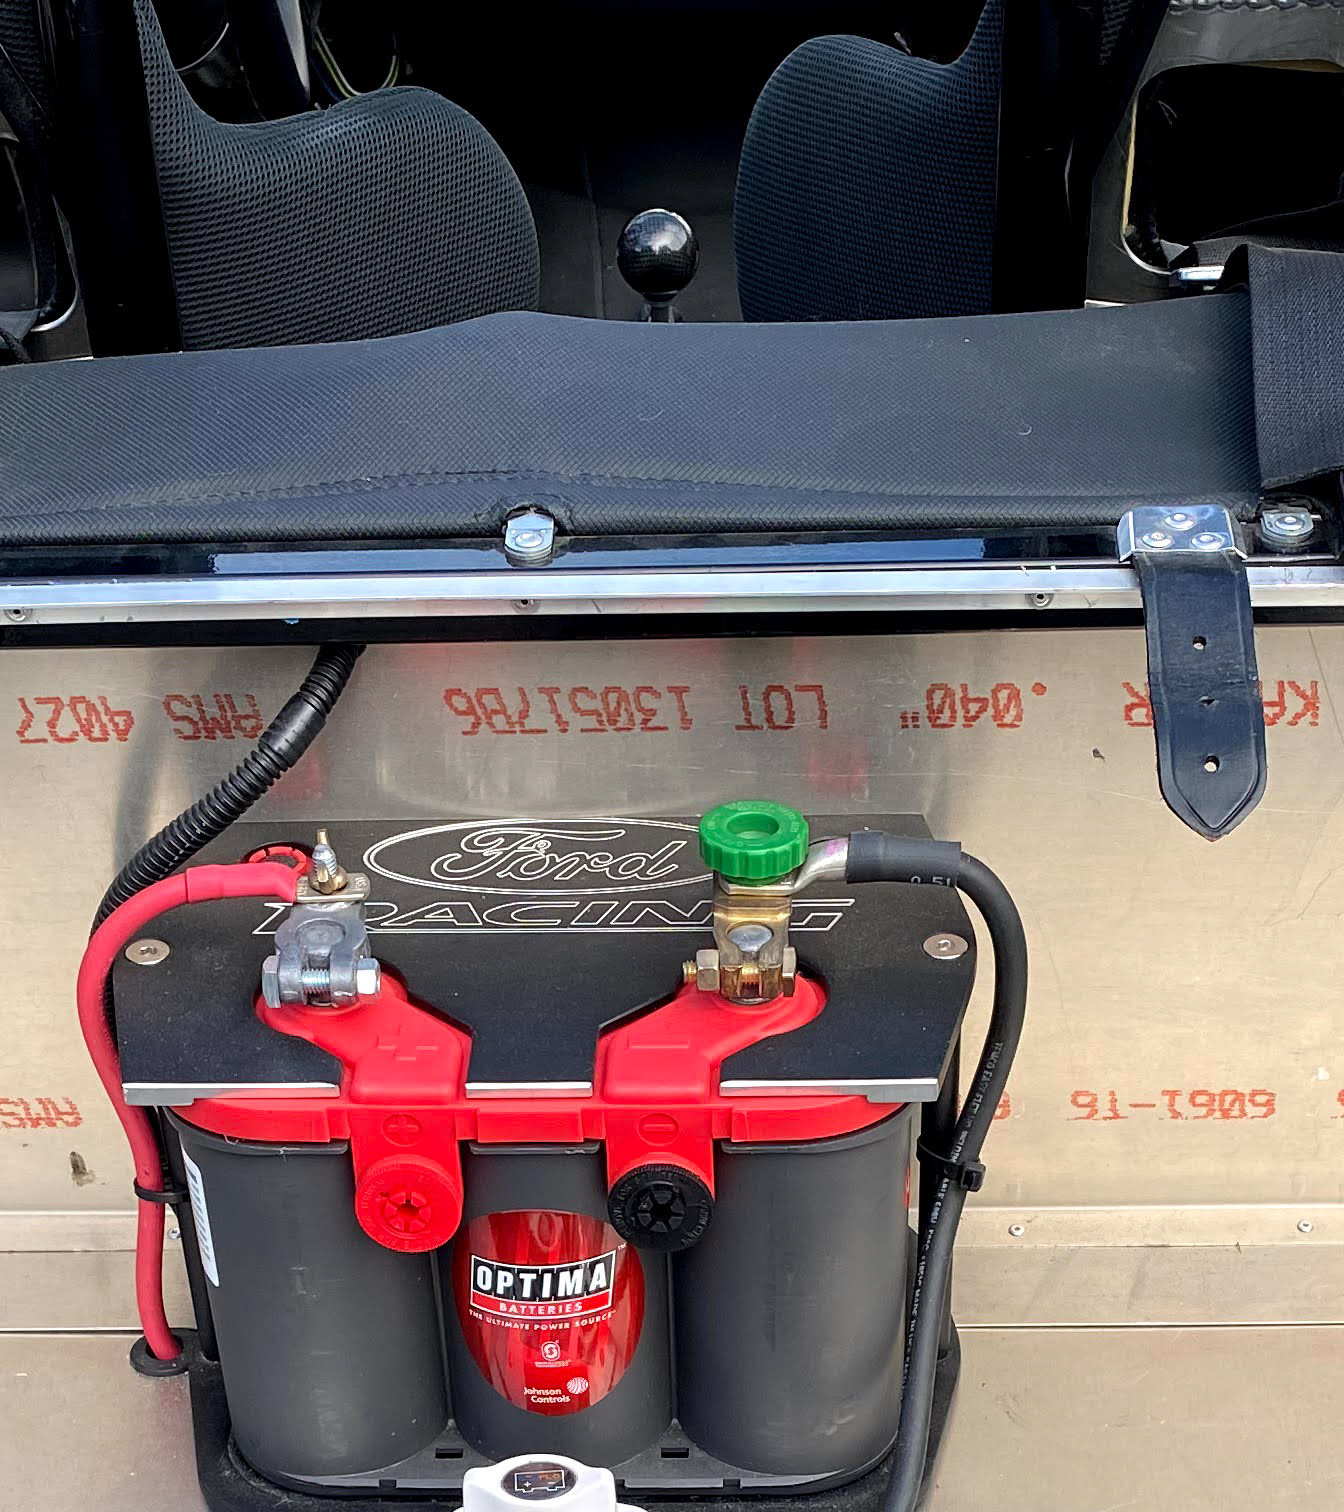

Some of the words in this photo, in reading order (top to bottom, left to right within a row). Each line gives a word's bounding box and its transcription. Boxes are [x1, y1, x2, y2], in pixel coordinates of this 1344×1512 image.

[15, 696, 136, 745] 4027
[163, 695, 265, 742] AMS
[734, 683, 829, 732] LOT
[428, 828, 686, 882] Ford
[1069, 1088, 1277, 1122] 6061-T6
[476, 1262, 608, 1299] OPTIMA
[469, 1308, 483, 1321] THE
[485, 1316, 530, 1331] ULTIMATE
[534, 1323, 570, 1331] POWER
[575, 1312, 613, 1328] SOURCE
[499, 1301, 583, 1315] BATTERIES
[524, 1387, 562, 1396] Johnson
[531, 1395, 571, 1404] Controls
